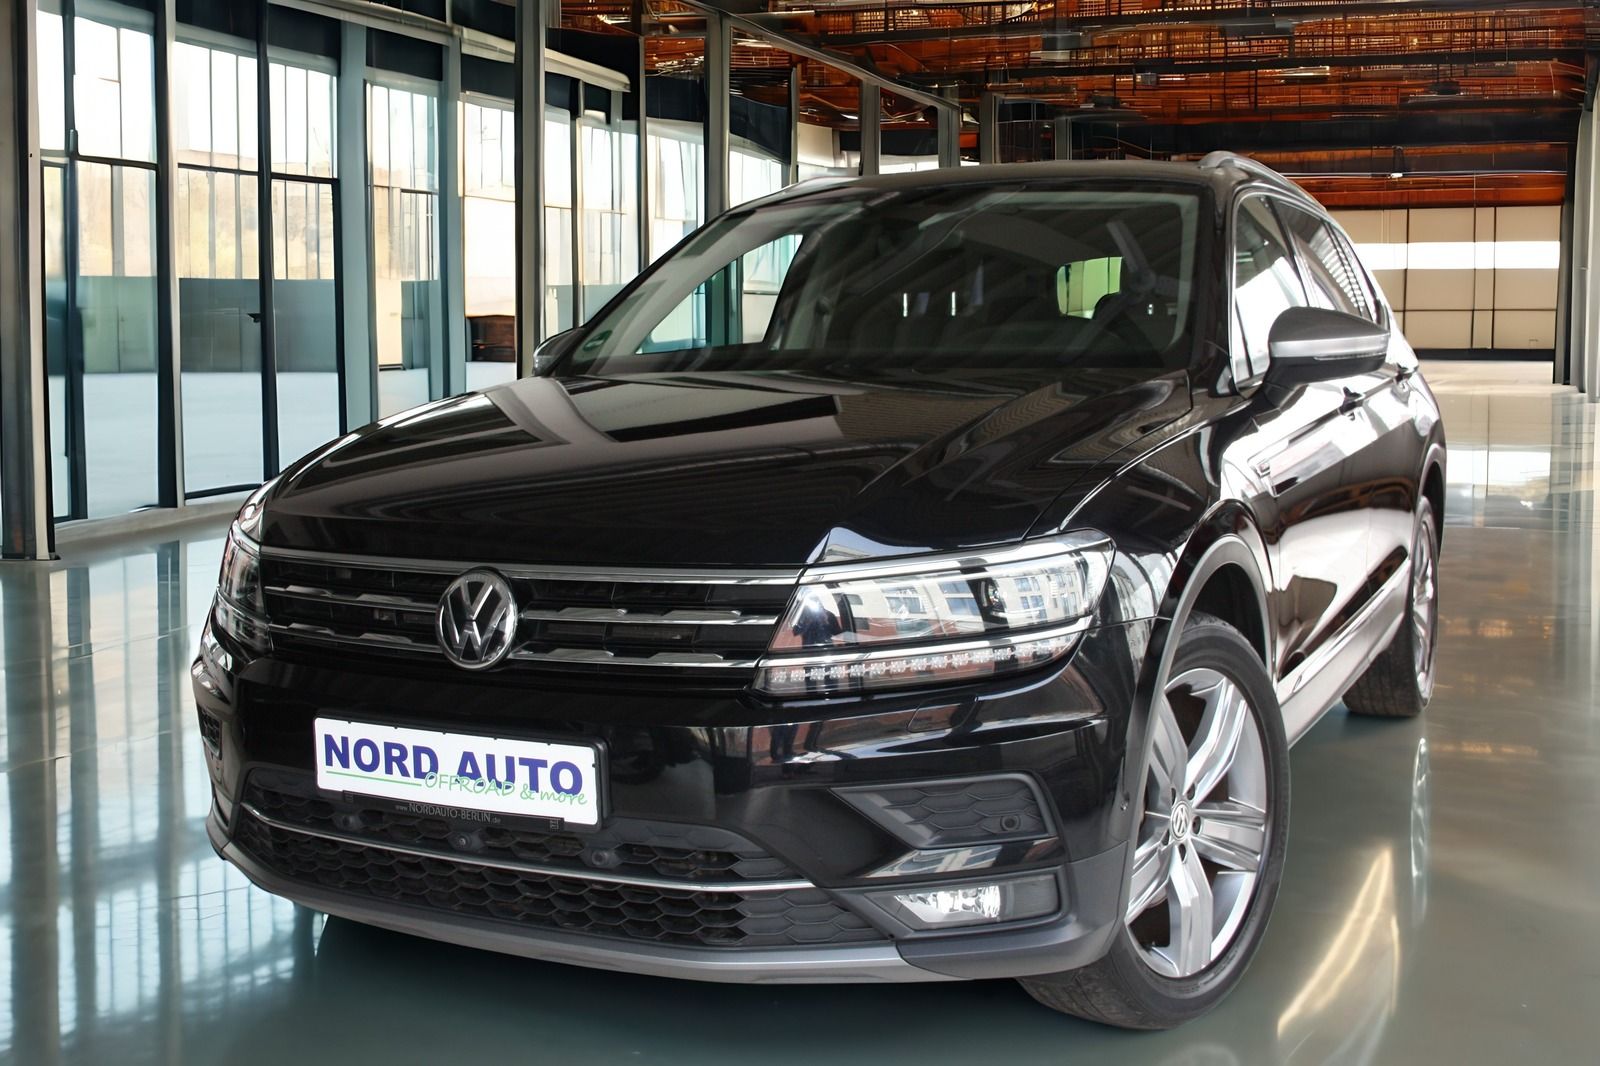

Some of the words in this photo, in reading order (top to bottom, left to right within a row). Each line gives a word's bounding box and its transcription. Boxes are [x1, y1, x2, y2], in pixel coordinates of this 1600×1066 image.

[324, 733, 439, 780] NORD
[454, 750, 583, 796] AUTO
[424, 771, 516, 797] OFFROAD
[520, 783, 535, 801] &
[540, 791, 588, 806] more
